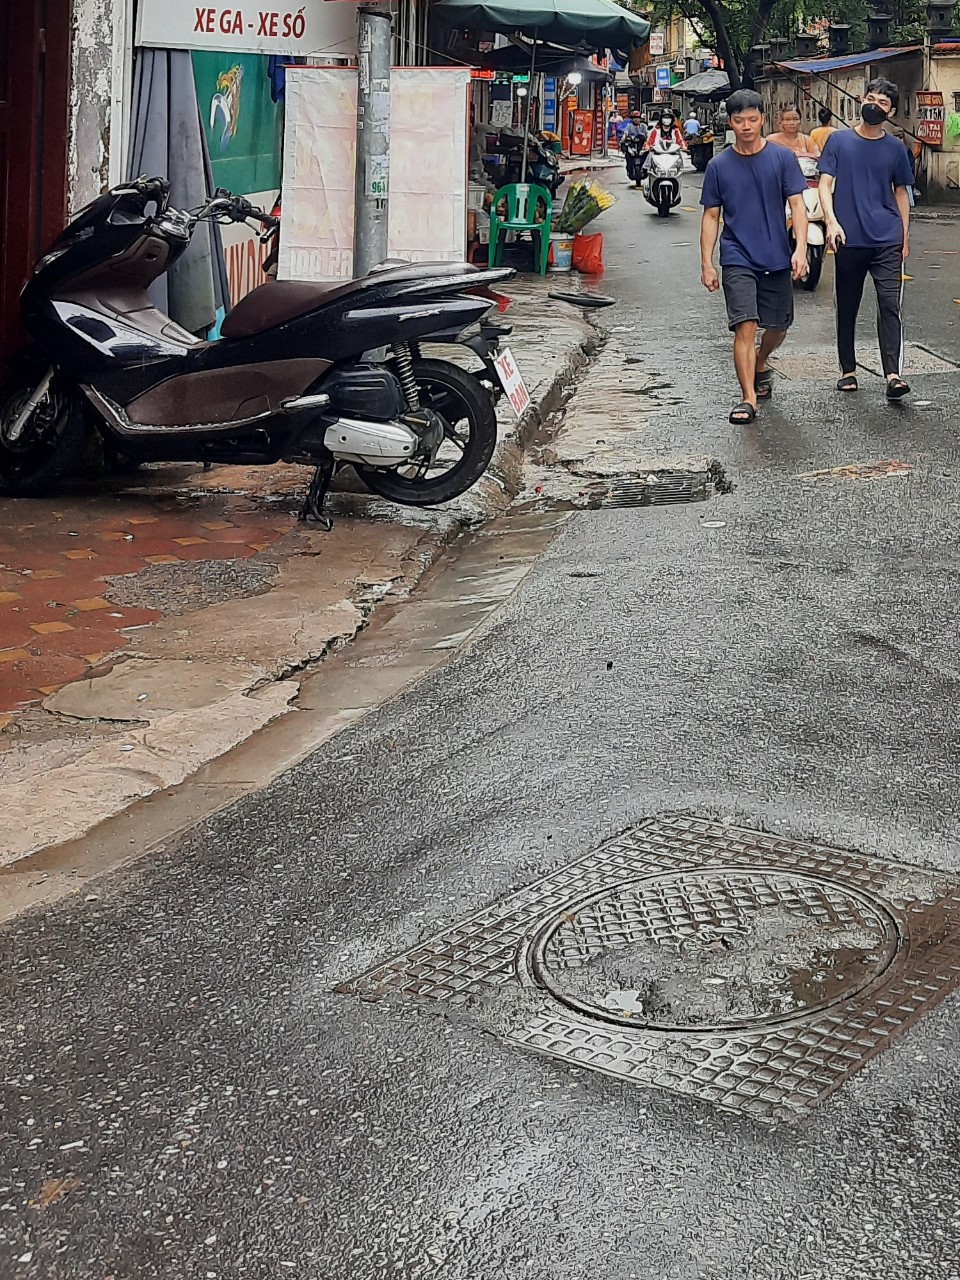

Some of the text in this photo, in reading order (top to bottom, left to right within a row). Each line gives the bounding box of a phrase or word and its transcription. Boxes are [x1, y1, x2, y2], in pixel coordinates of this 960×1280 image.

[193, 7, 216, 32] XE
[219, 10, 243, 35] GA
[257, 12, 279, 37] XE
[282, 6, 306, 39] SỐ
[497, 355, 514, 381] XE
